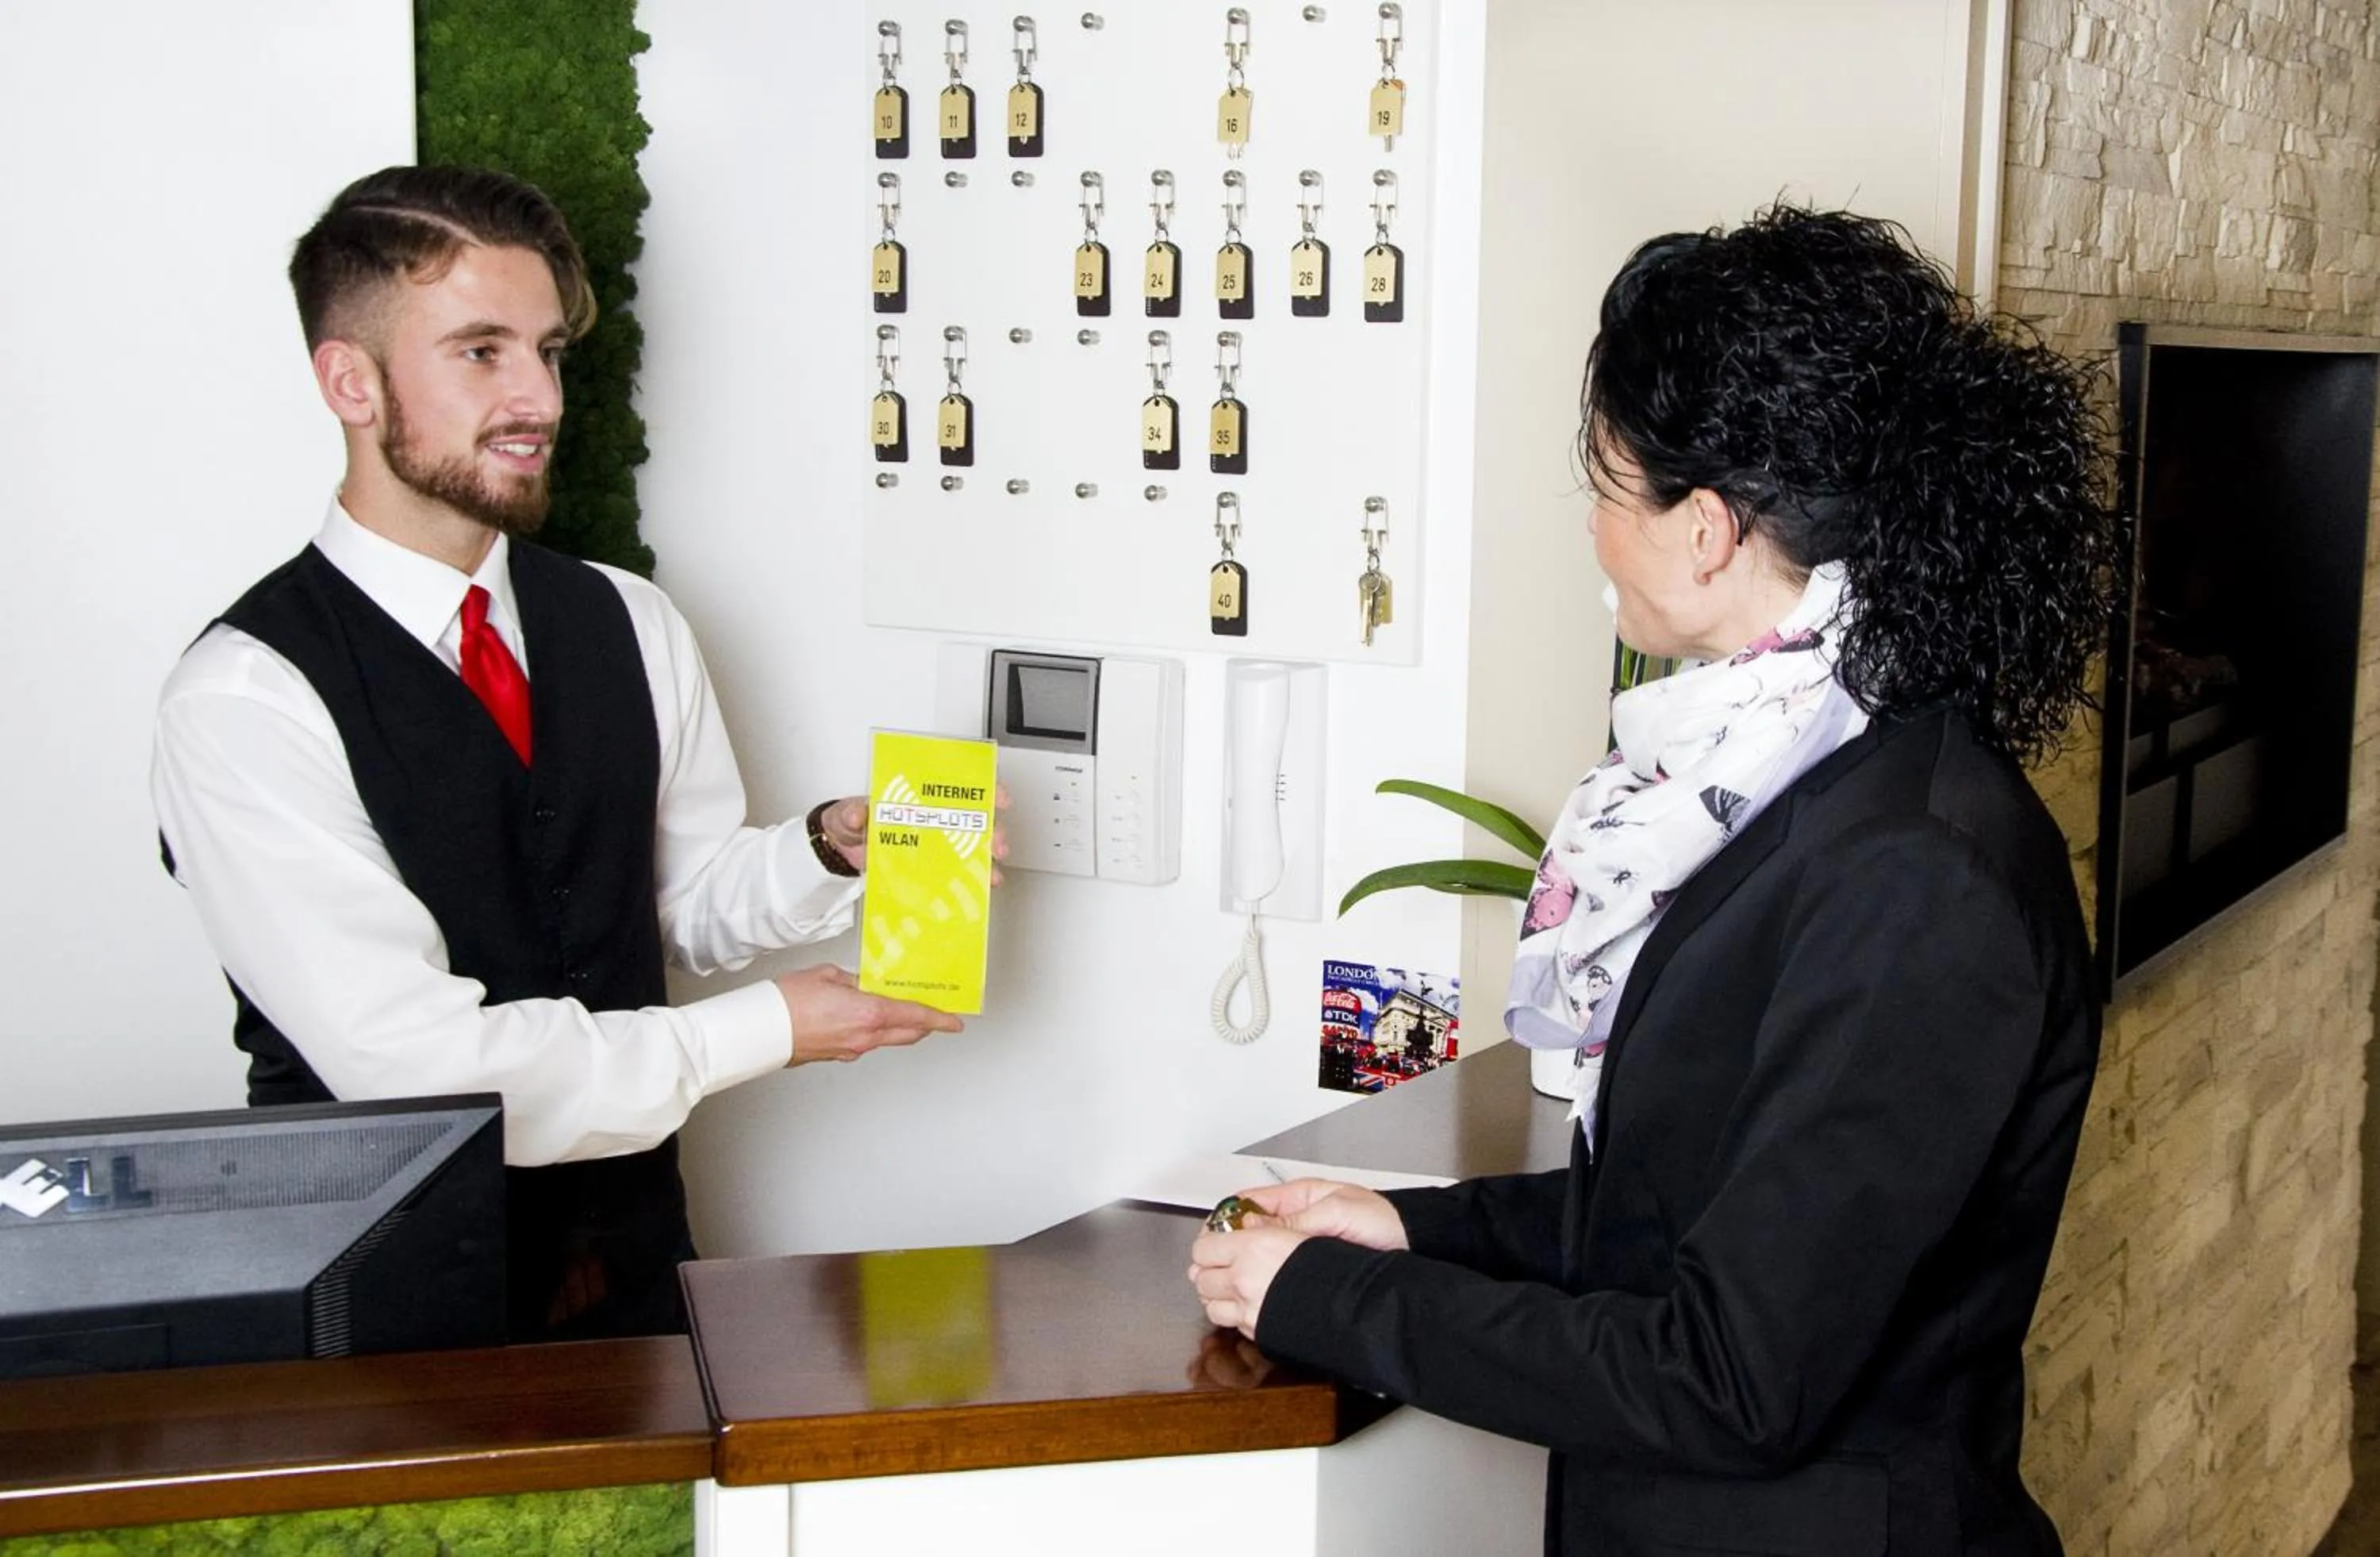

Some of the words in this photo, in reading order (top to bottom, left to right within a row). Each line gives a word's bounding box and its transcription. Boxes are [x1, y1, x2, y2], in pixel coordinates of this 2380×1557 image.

[881, 115, 892, 129] 10
[948, 114, 958, 128] 11
[1015, 113, 1027, 127] 12
[1226, 118, 1238, 133] 16
[878, 270, 891, 283] 20
[1080, 273, 1092, 287] 23
[1151, 274, 1164, 288] 24
[1223, 275, 1235, 289] 25
[1299, 271, 1313, 286] 26
[1372, 278, 1386, 292] 28
[877, 421, 889, 435] 30
[945, 425, 956, 438] 31
[1148, 426, 1161, 441] 34
[1216, 430, 1230, 444] 35
[1218, 594, 1231, 608] 40
[922, 783, 985, 801] INTERNET
[880, 808, 983, 828] HOTSPLOTS
[880, 831, 919, 847] WLAN
[1332, 1010, 1358, 1025] TDK
[0, 1156, 153, 1218] ELL
